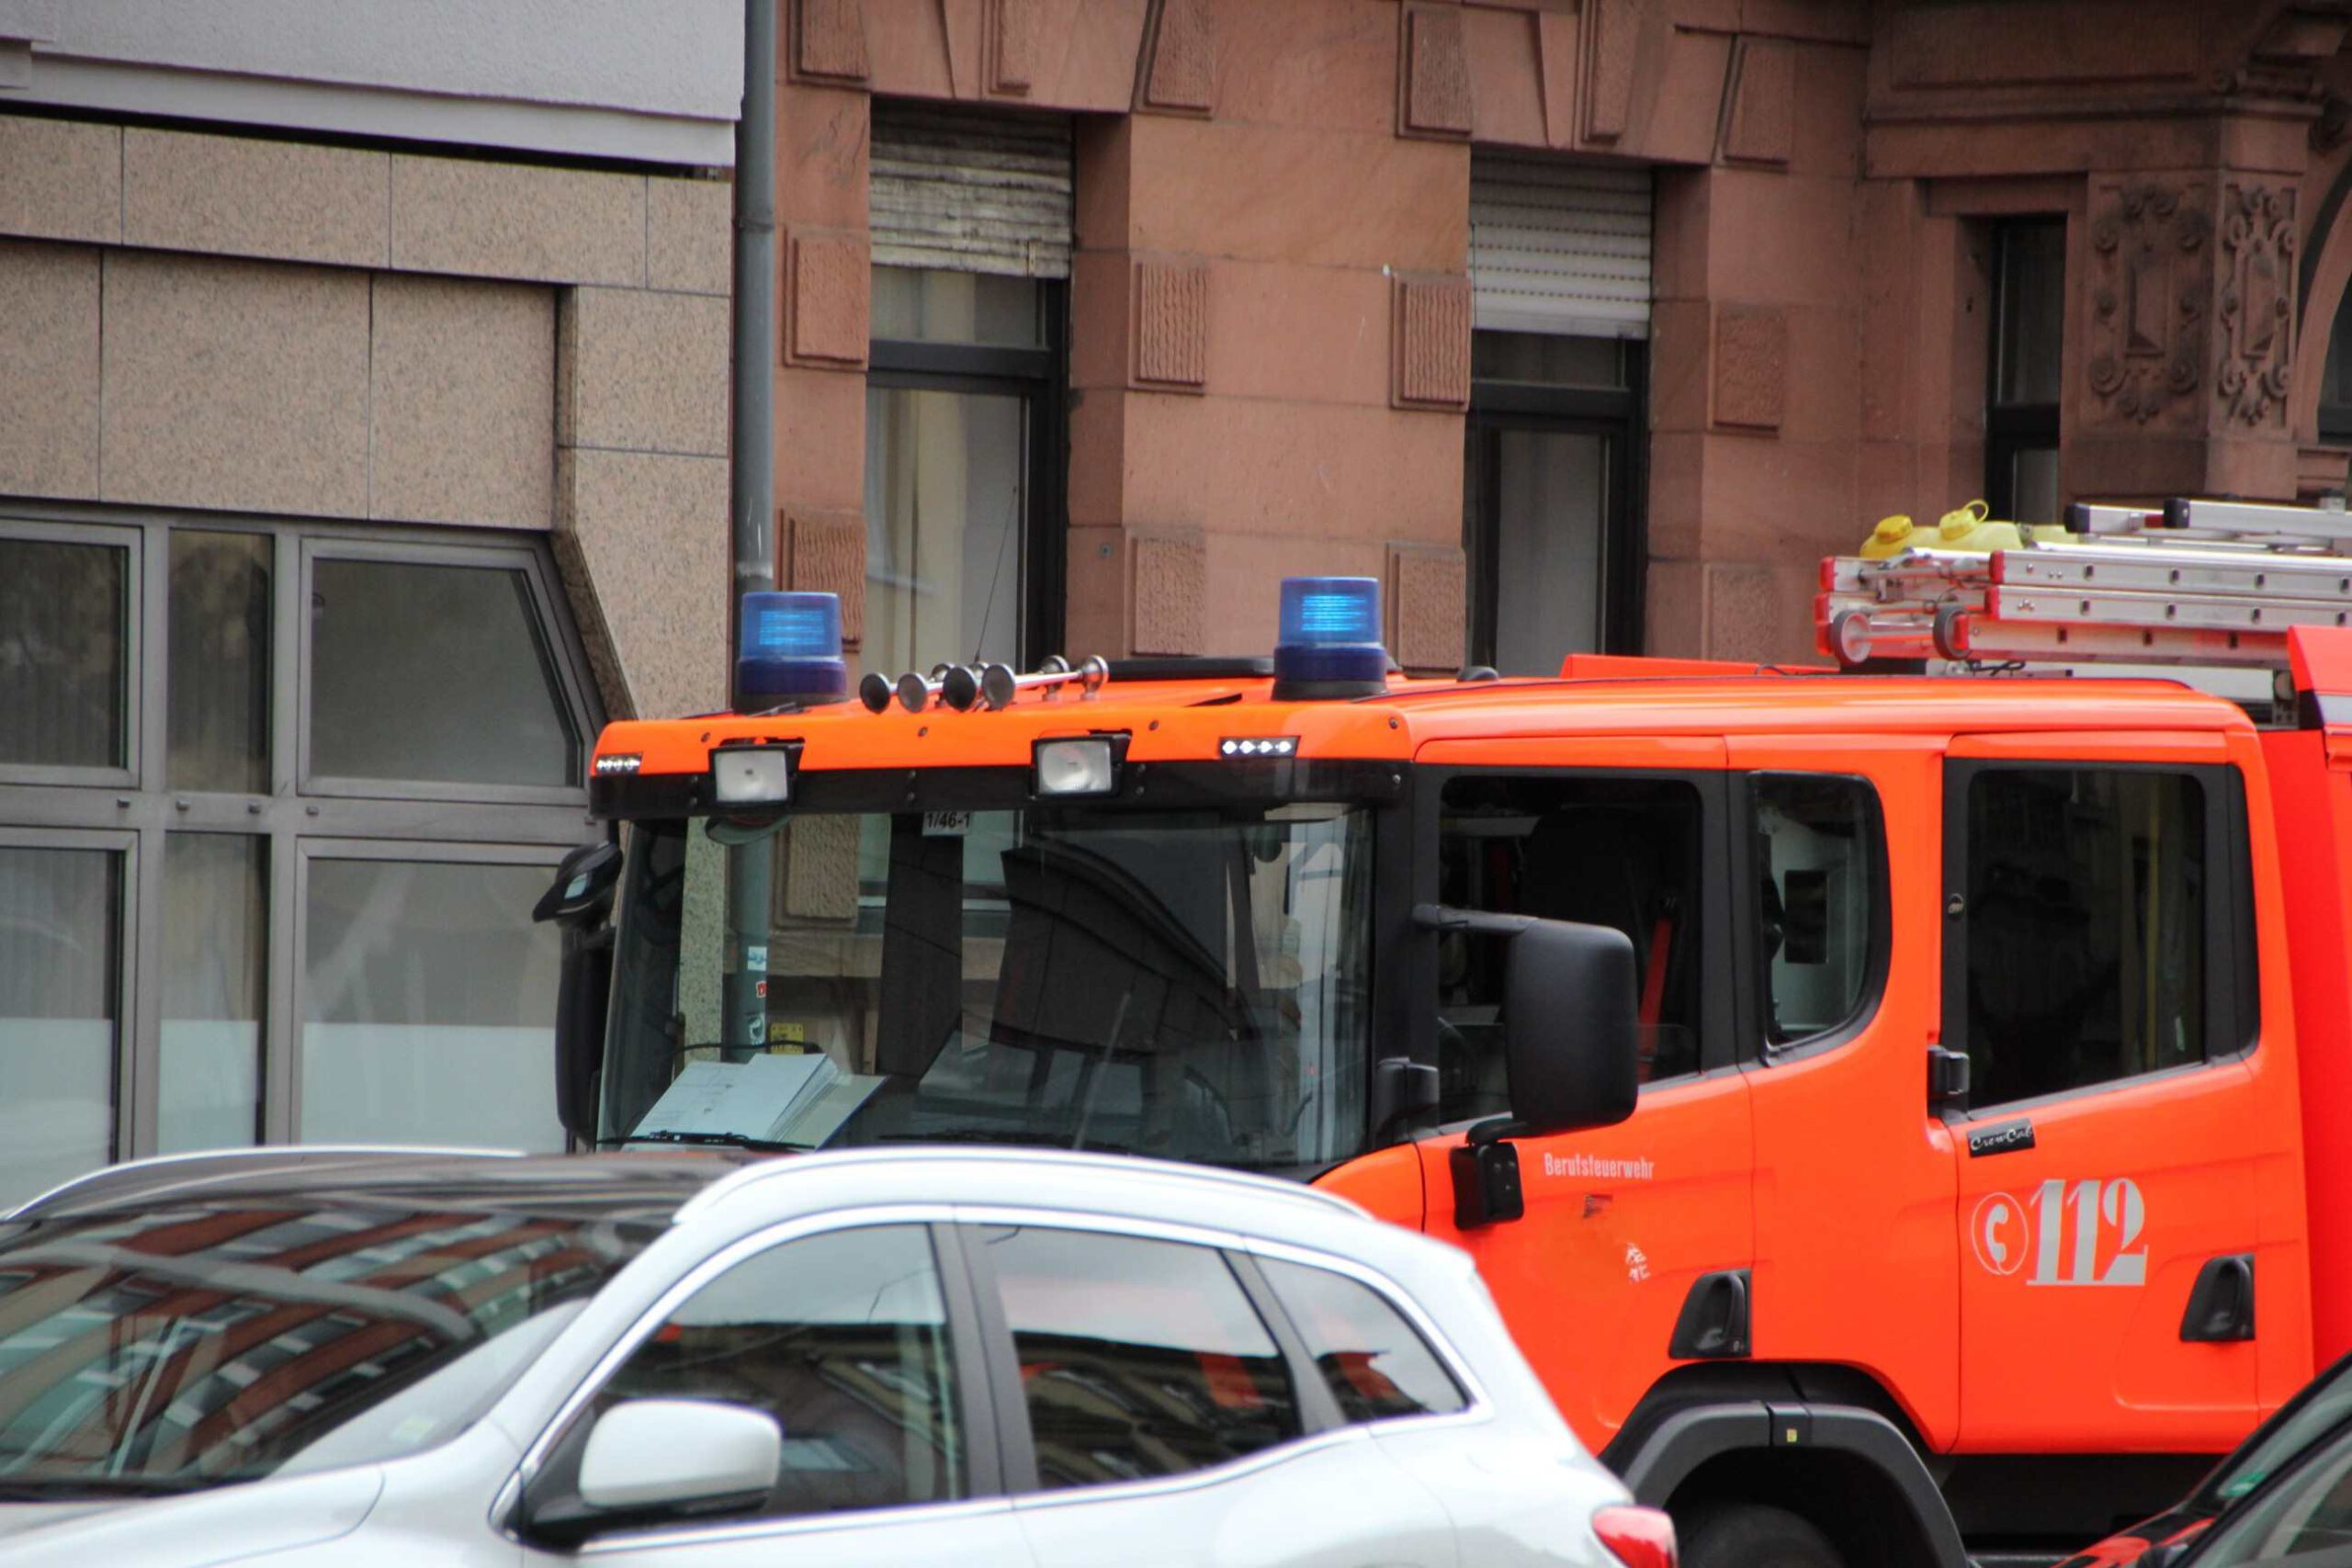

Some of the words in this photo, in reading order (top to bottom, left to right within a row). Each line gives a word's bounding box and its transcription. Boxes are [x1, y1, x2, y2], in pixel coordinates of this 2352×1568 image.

[926, 812, 970, 829] 1/46-1
[1544, 1152, 1655, 1179] Berufsfeuerwehr
[2027, 1178, 2148, 1286] 112
